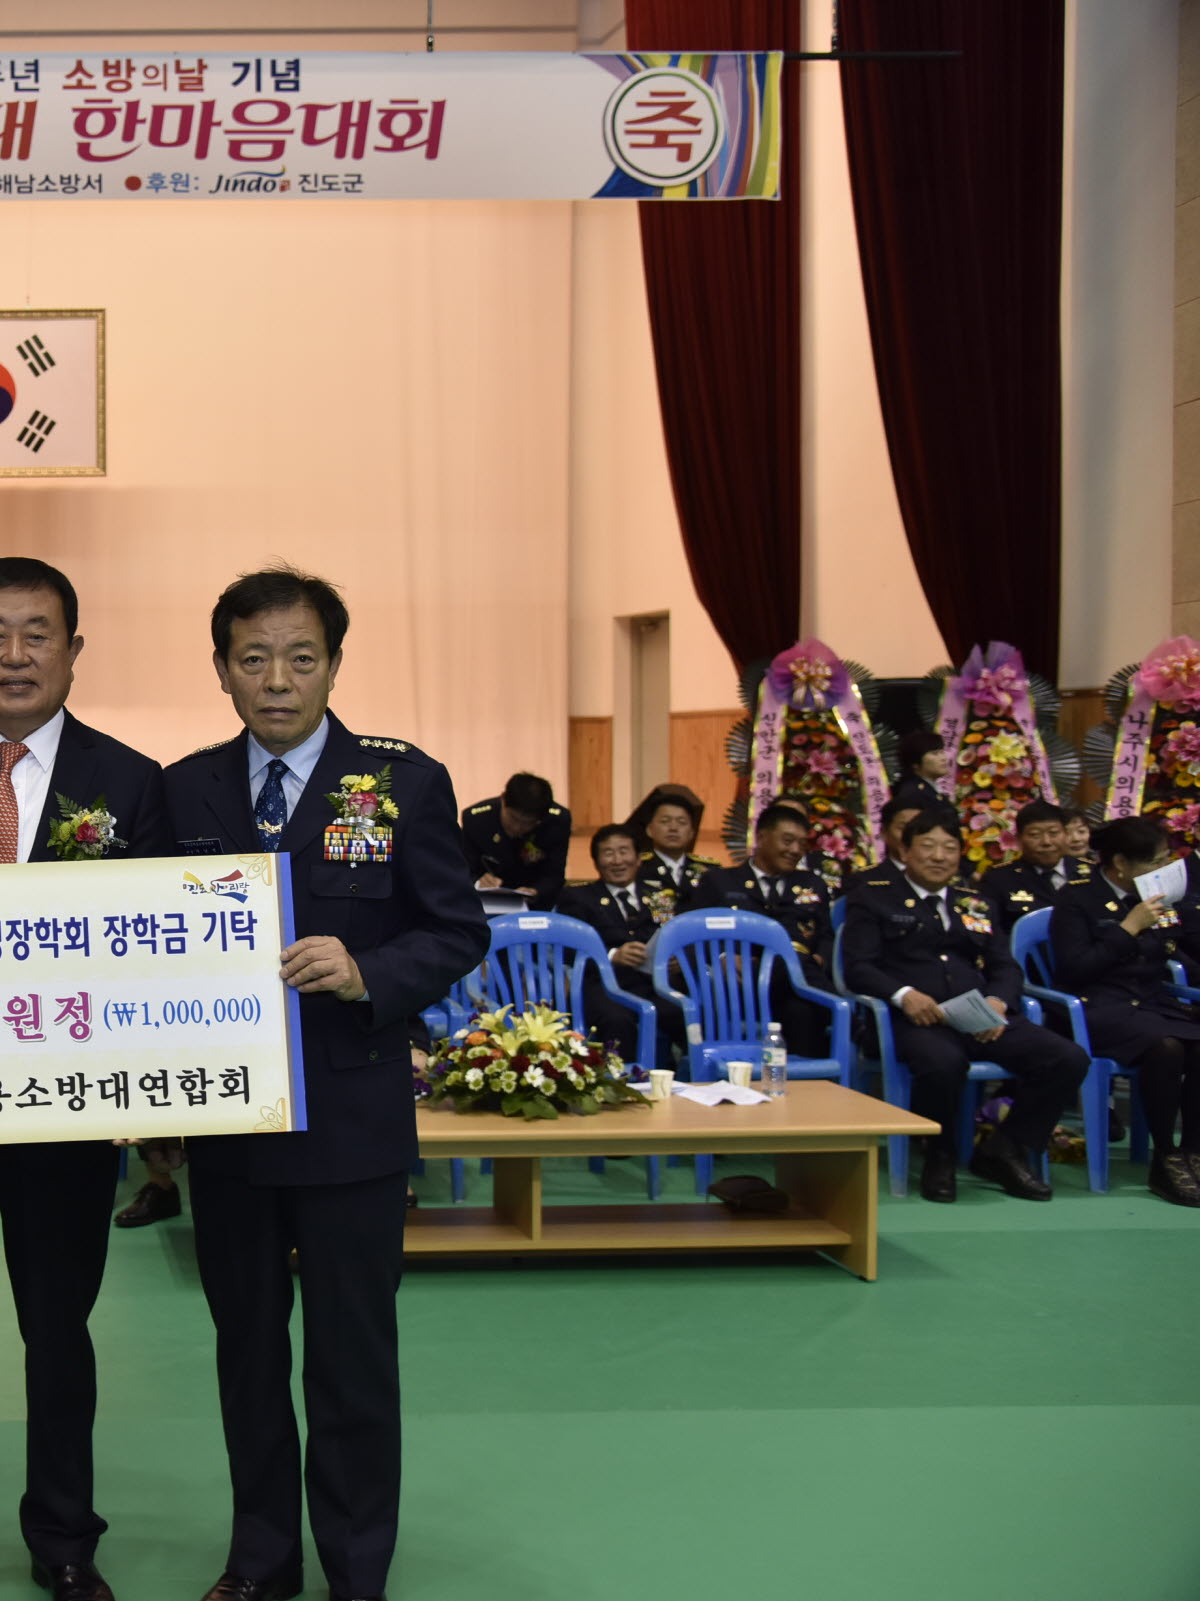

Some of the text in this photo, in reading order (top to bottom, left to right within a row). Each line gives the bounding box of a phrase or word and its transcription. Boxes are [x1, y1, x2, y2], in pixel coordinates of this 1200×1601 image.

[61, 57, 209, 94] 소방의날
[231, 57, 302, 93] 기념
[71, 98, 448, 163] 한마음대회
[622, 88, 705, 164] 축
[146, 173, 365, 195] 후원: Jindo 진도군
[102, 912, 189, 959] 장학금
[201, 910, 259, 953] 기탁
[102, 992, 262, 1032] (₩1,000,000)
